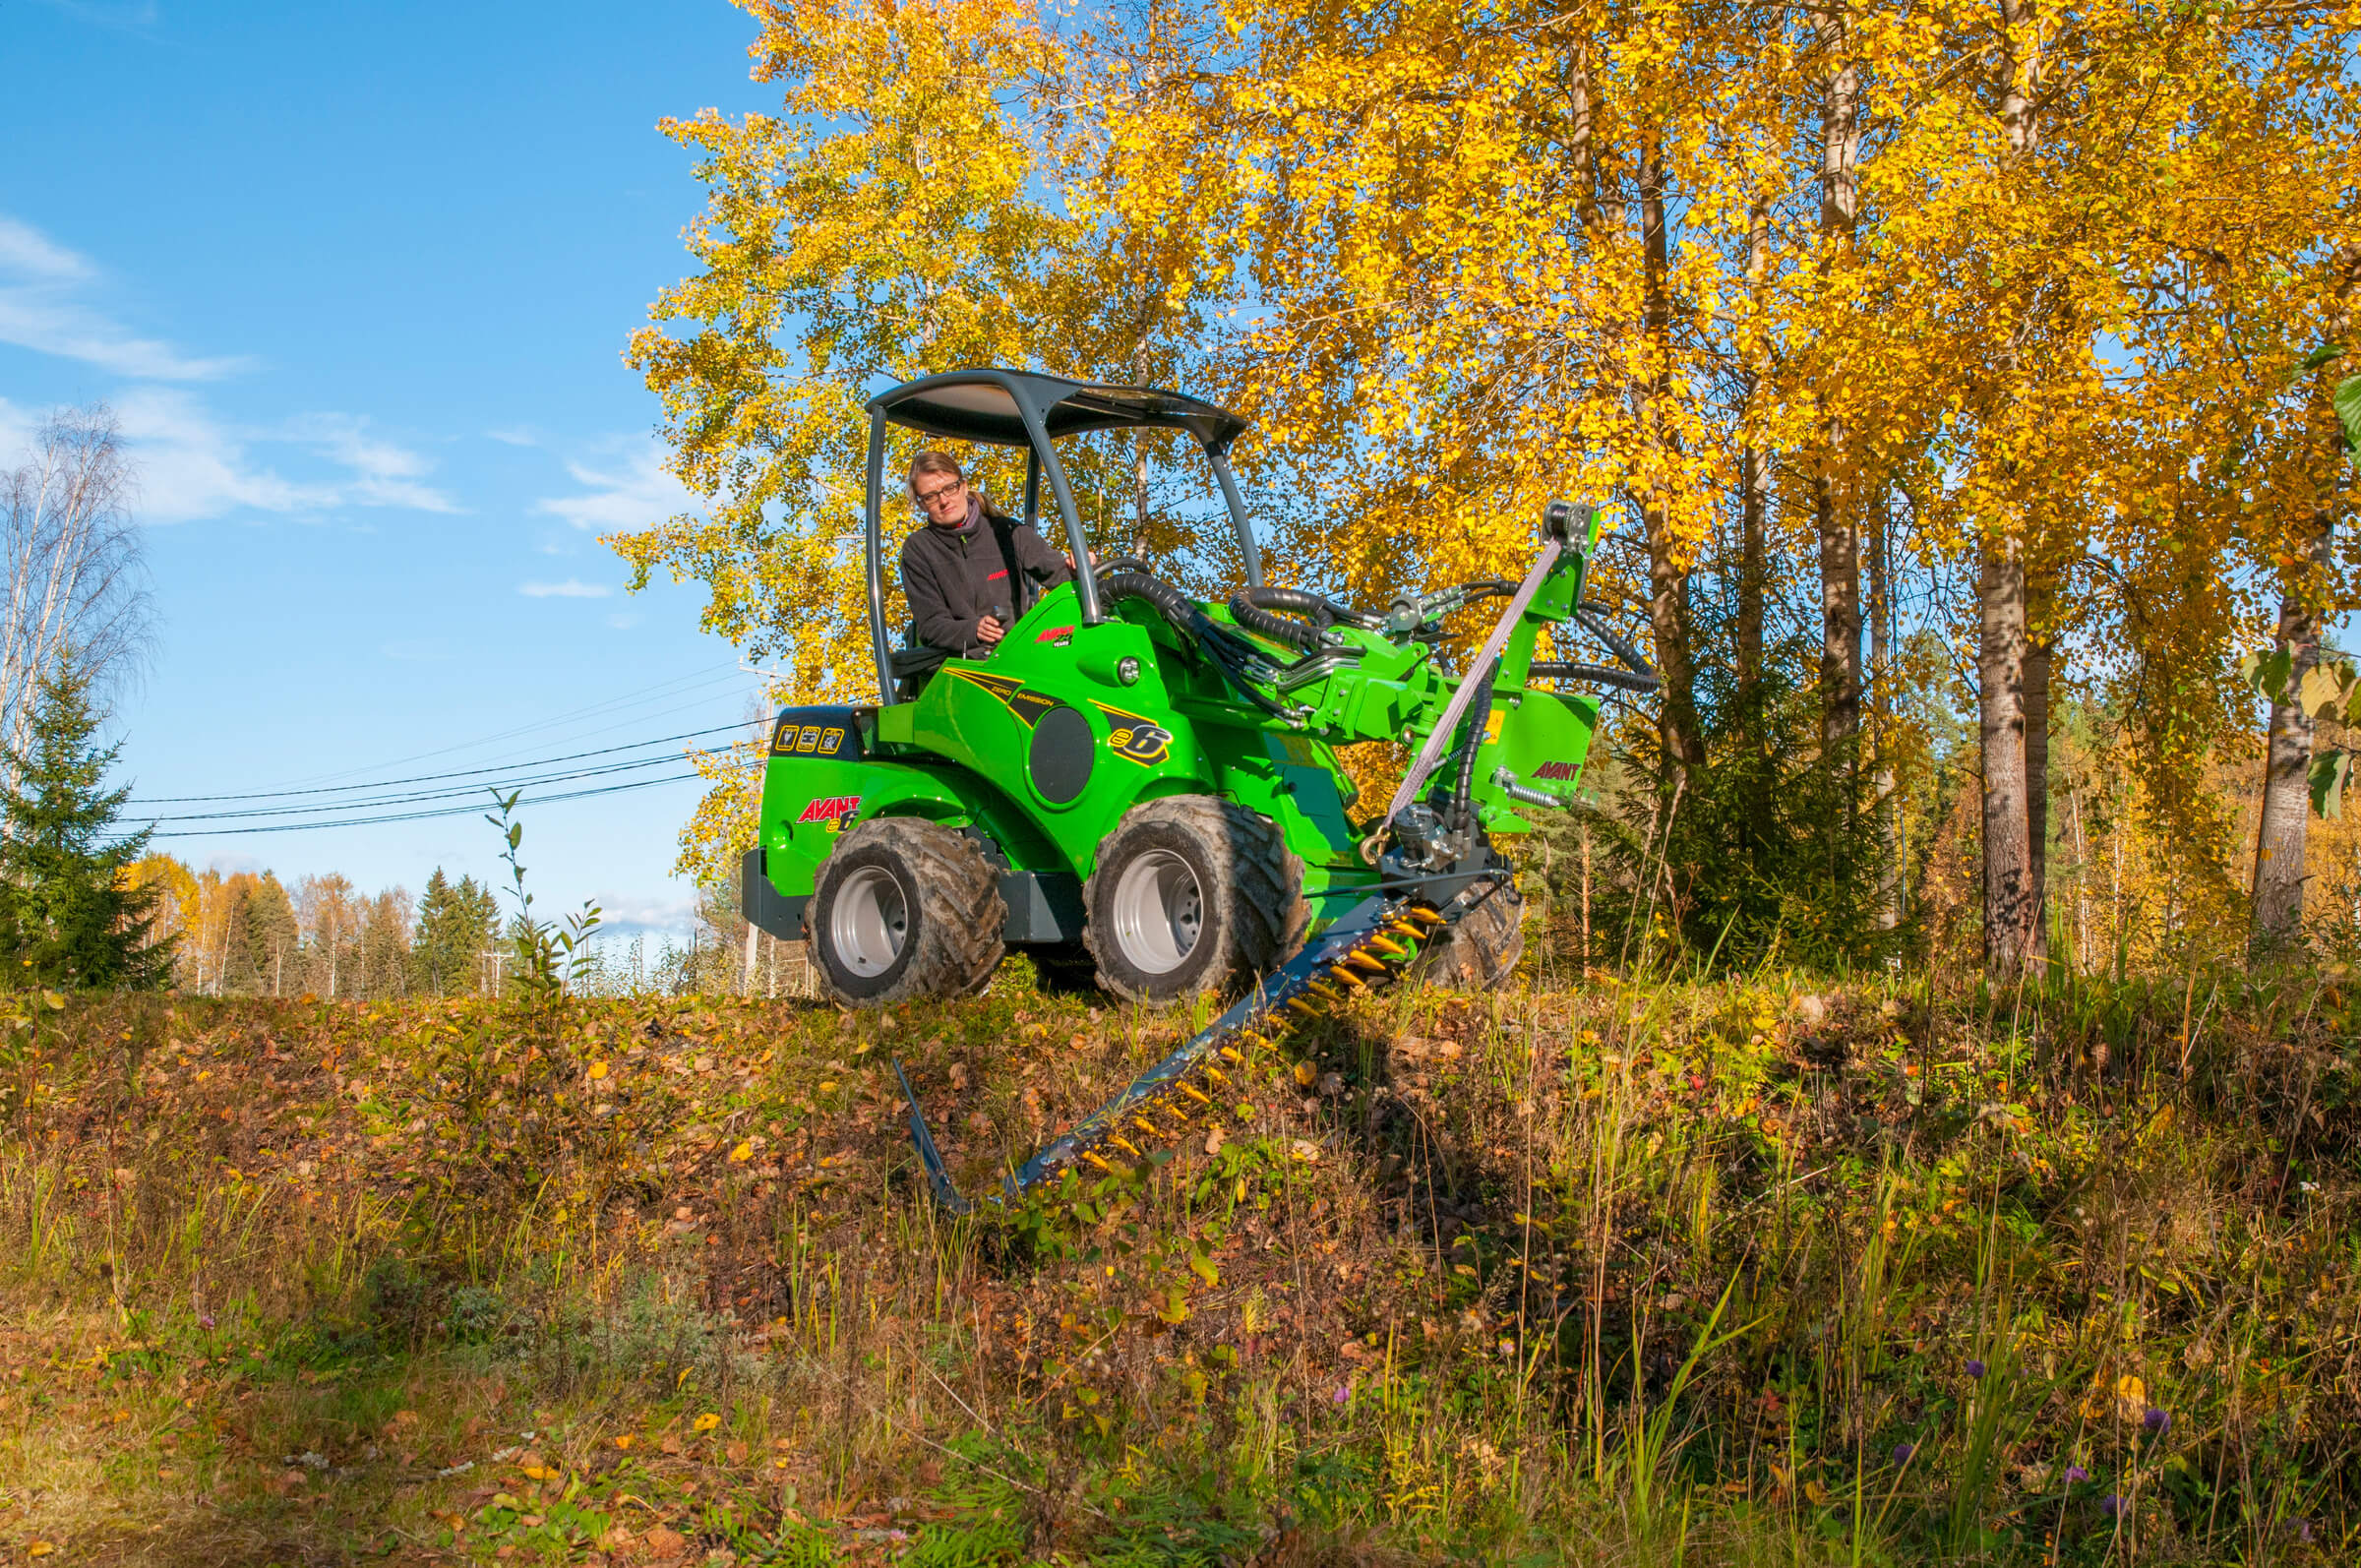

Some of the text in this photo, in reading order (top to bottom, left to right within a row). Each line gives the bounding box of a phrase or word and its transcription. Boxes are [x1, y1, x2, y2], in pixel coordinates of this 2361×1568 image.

[992, 686, 1054, 706] ZERO EMISSION
[1530, 760, 1582, 781] AVANT
[795, 795, 862, 824] AVANT
